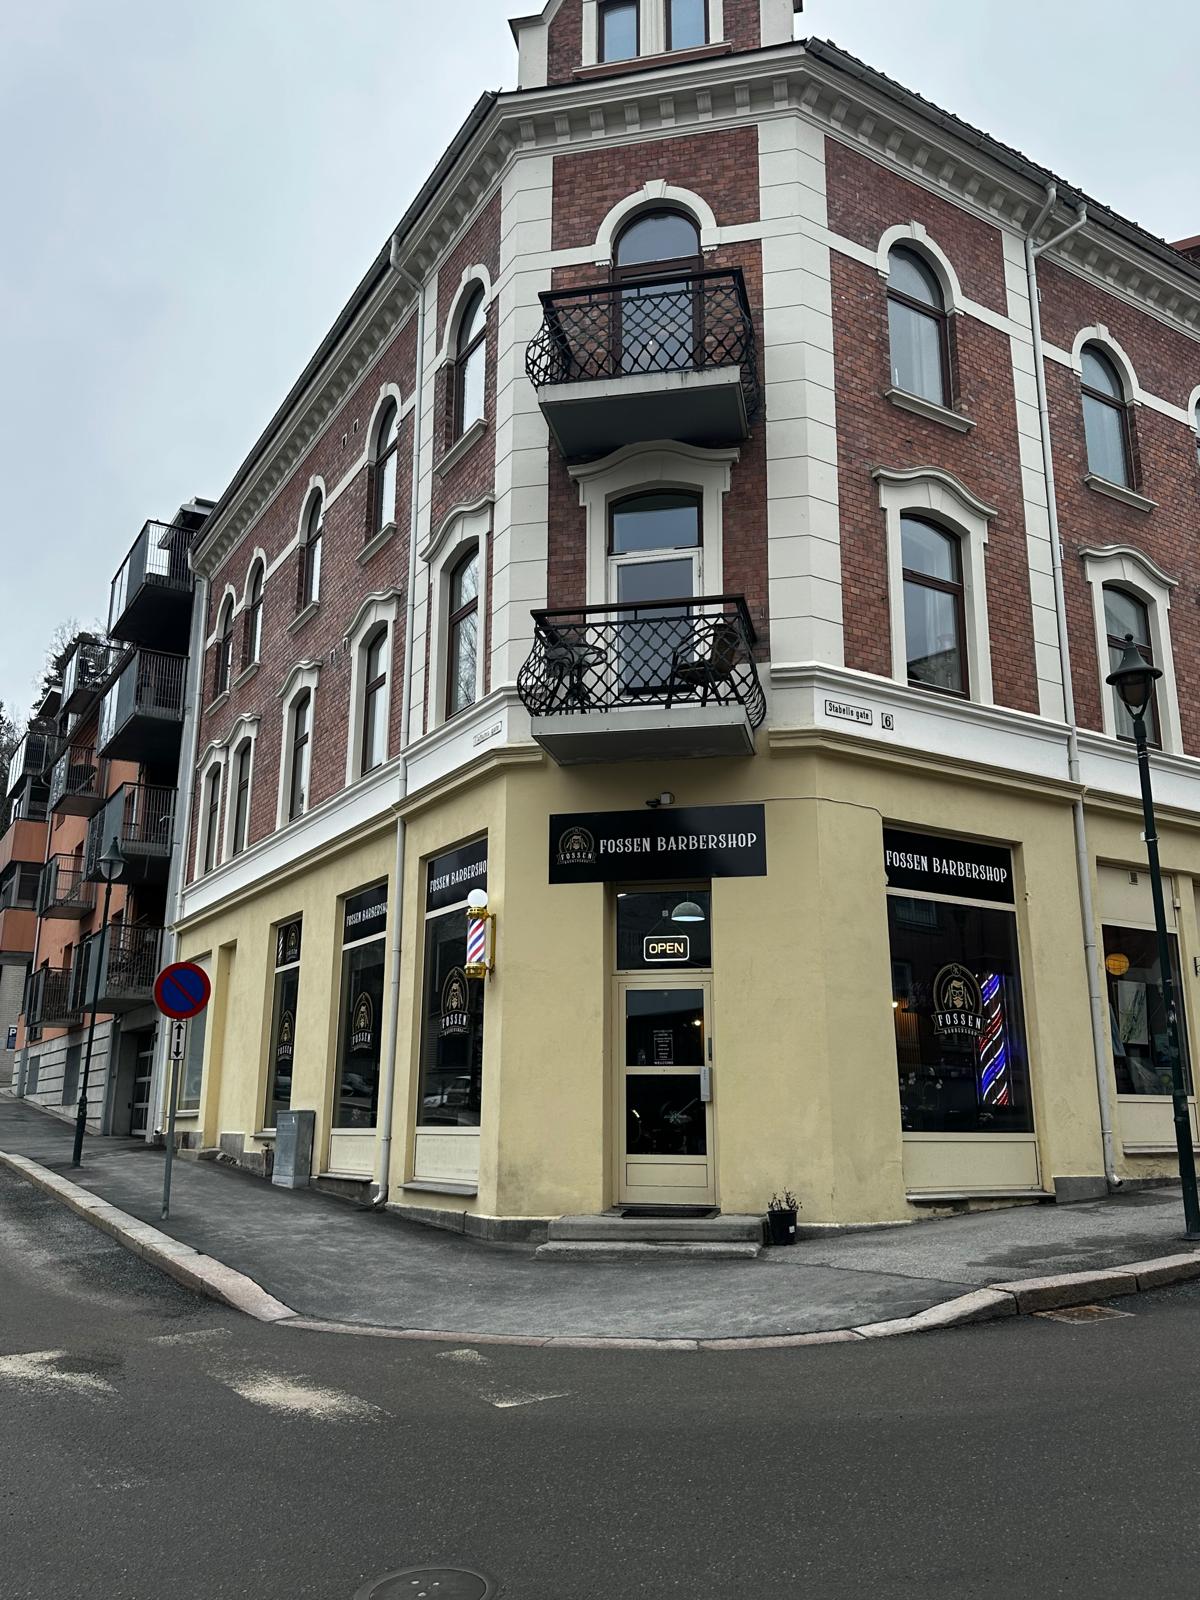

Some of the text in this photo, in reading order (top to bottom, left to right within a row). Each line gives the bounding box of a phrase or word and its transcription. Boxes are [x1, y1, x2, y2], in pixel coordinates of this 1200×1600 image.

[828, 702, 869, 720] Stabells gate
[885, 715, 892, 728] 6
[600, 832, 757, 854] FOSSEN BARBERSHOP
[560, 851, 593, 861] FOSSEN
[886, 850, 1008, 883] FOSSEN BARBERSHOP
[429, 873, 450, 893] FOSSEN
[649, 942, 684, 954] OPEN
[442, 1013, 467, 1029] FOSSEN
[938, 1012, 981, 1030] FOSSEN
[9, 1028, 17, 1036] P
